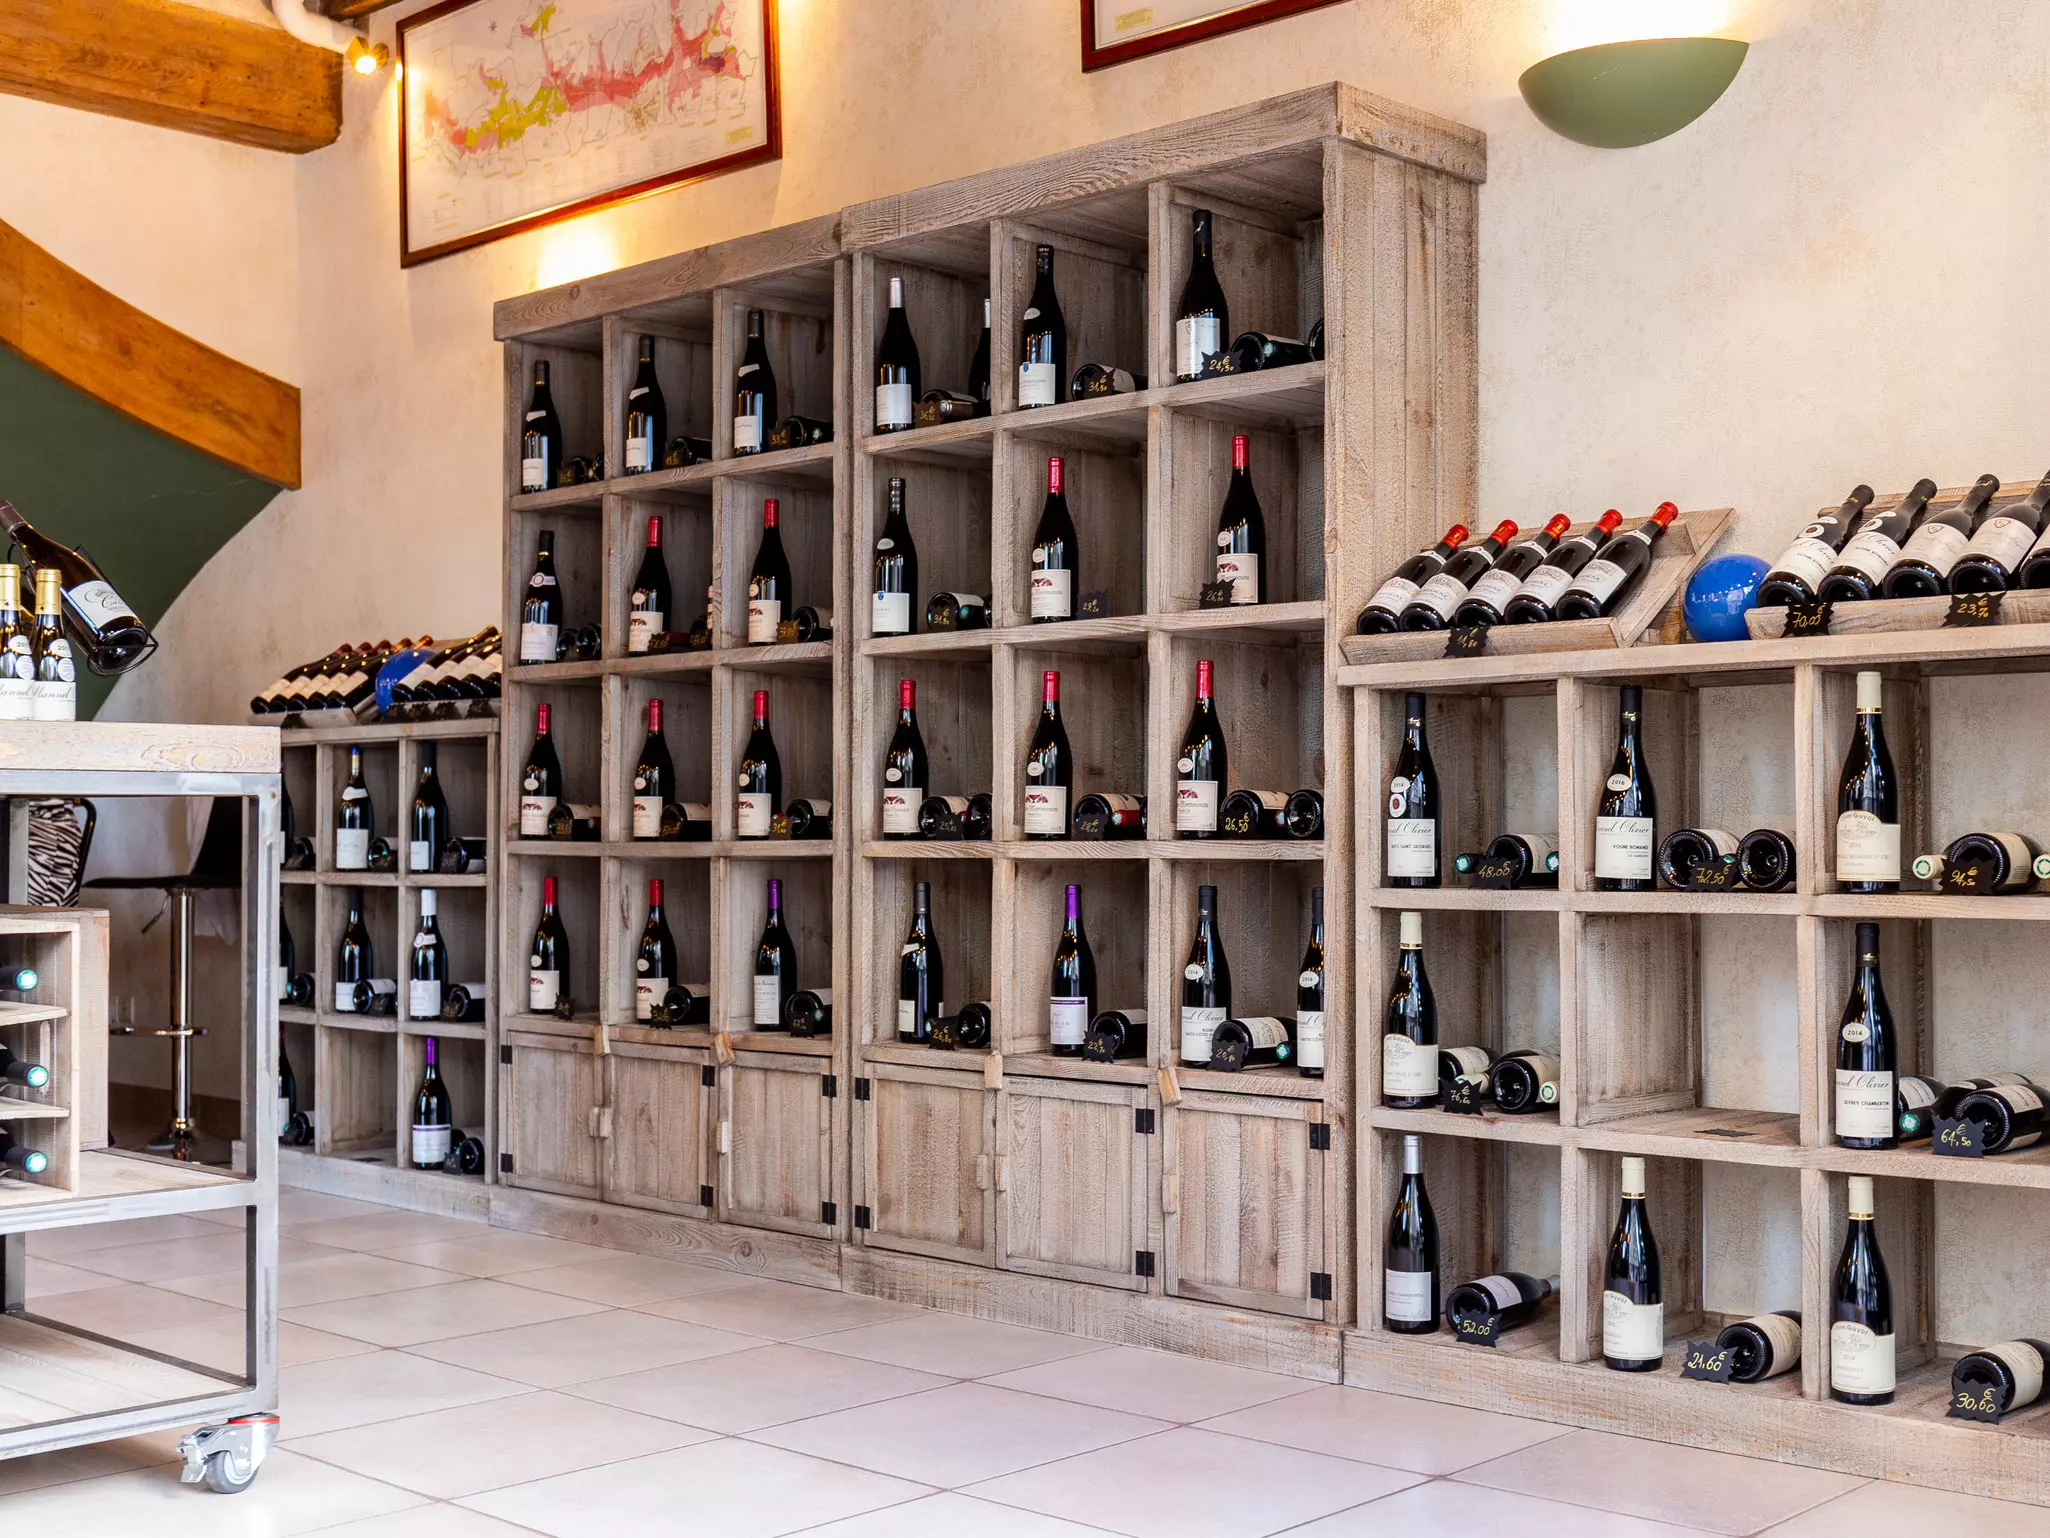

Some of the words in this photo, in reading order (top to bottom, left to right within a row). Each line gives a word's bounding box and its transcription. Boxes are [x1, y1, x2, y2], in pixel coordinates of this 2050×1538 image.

[1792, 604, 1826, 628] 70,00€
[1225, 812, 1250, 833] 26,50€
[1403, 821, 1432, 834] Olivier
[1619, 819, 1649, 833] Olivier
[1478, 860, 1511, 879] 48,00€
[1696, 864, 1732, 885] 72,50€
[1857, 1073, 1889, 1089] Olivier
[1940, 1123, 1972, 1148] 64,50€
[1462, 1317, 1495, 1336] 52,00€
[1846, 1324, 1869, 1336] Guyot
[1956, 1387, 1996, 1413] 30,60€
